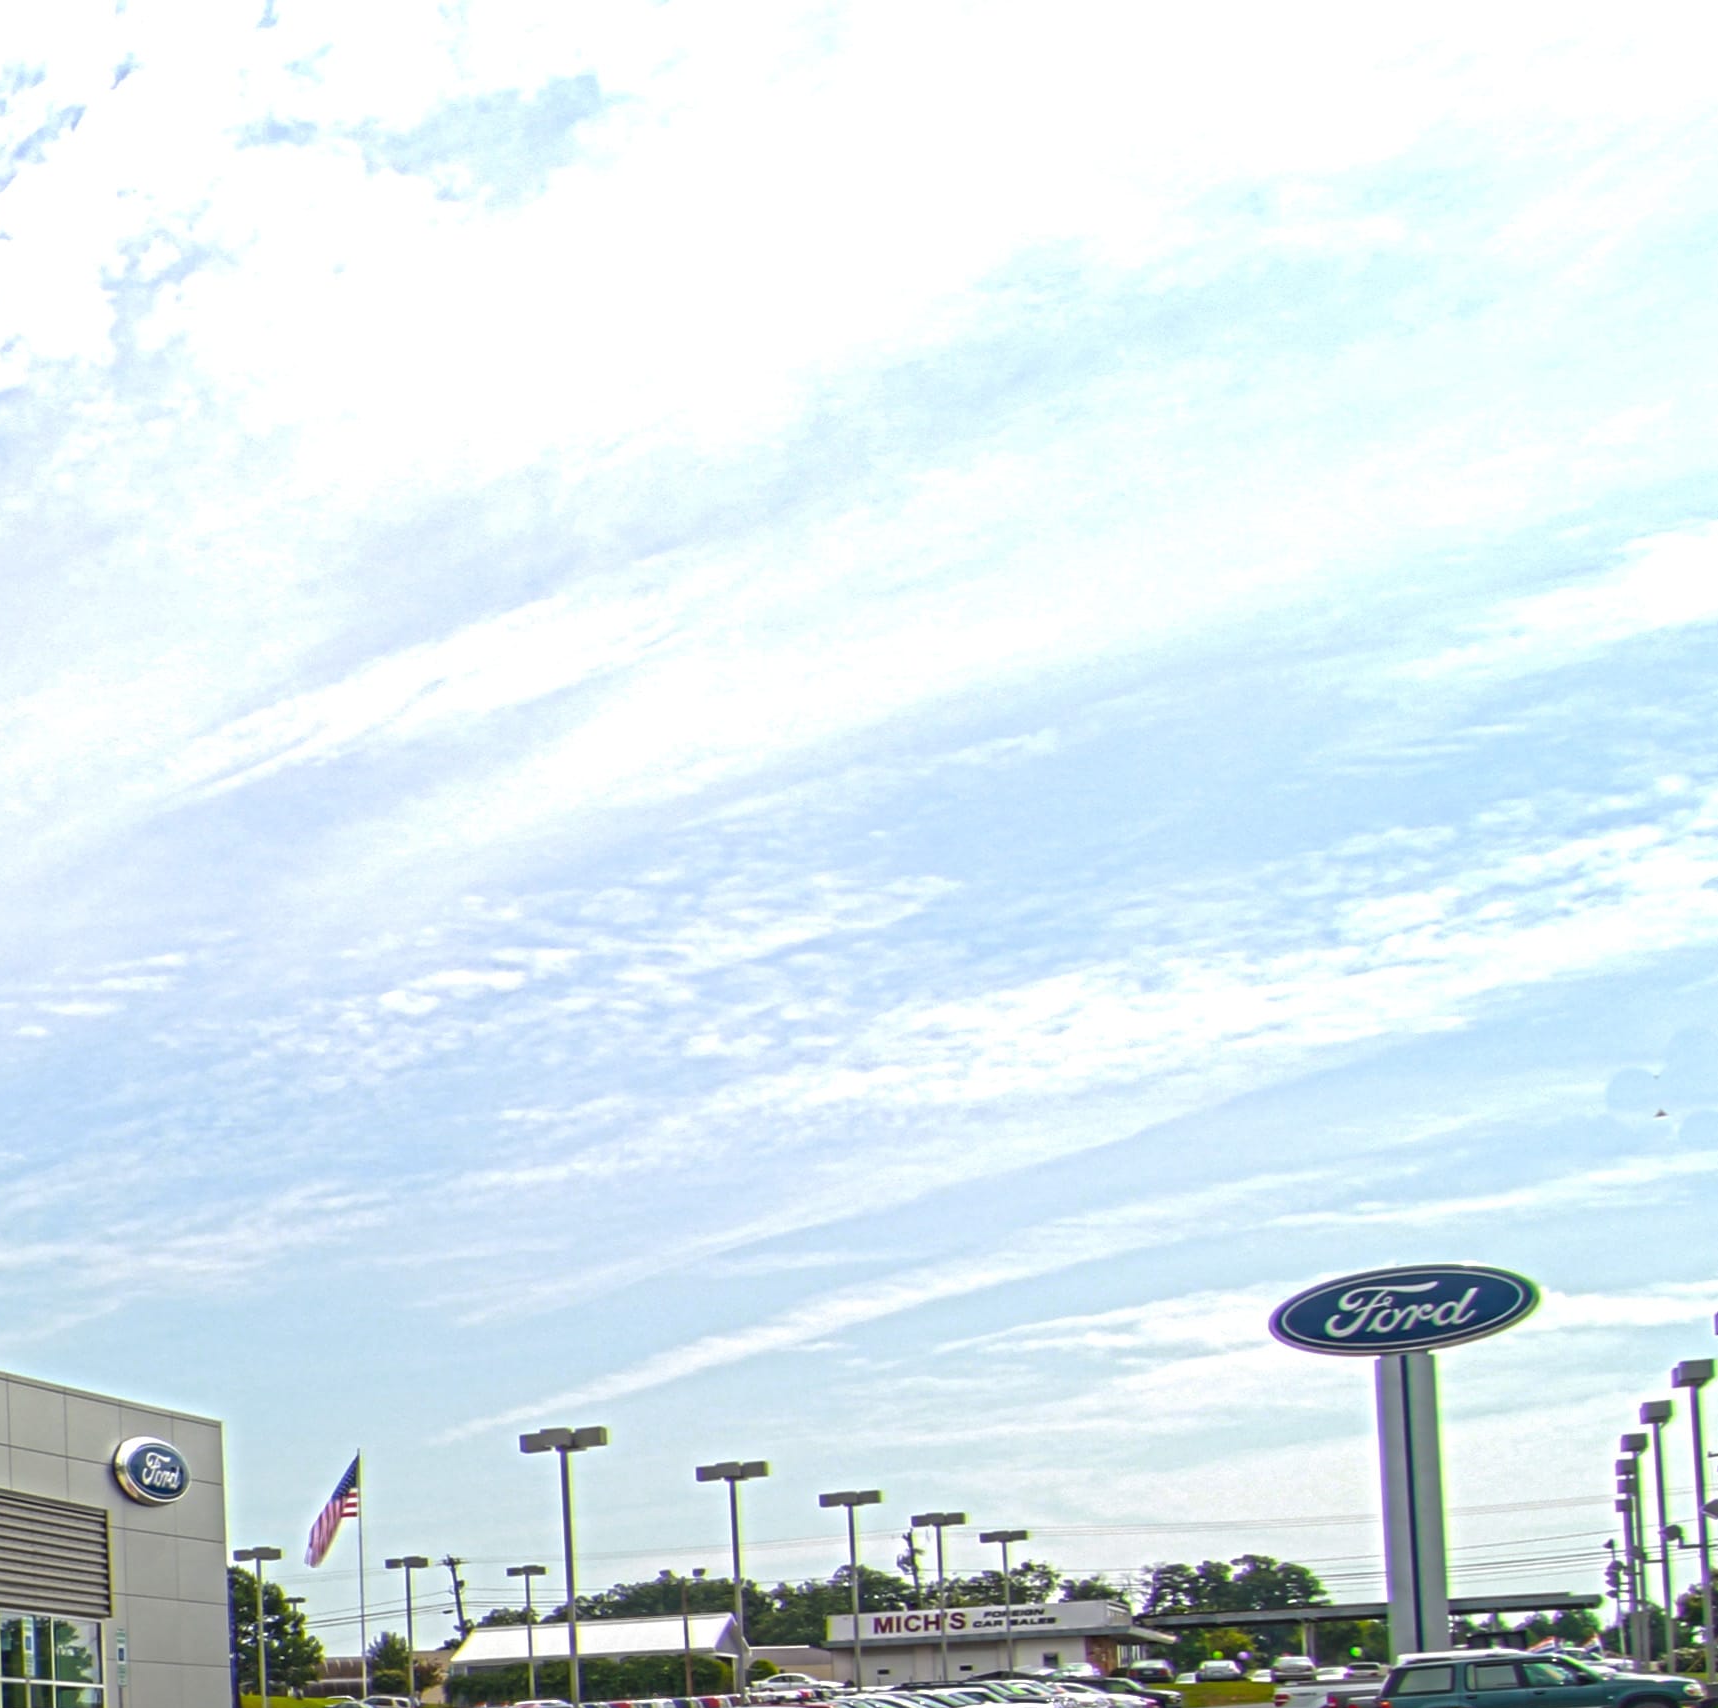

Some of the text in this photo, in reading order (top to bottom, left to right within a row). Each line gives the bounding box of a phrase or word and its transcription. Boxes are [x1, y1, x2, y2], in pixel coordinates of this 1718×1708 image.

[1324, 1281, 1479, 1338] Ford
[142, 1452, 181, 1489] Ford
[873, 1612, 966, 1634] MICH'S
[972, 1620, 1003, 1628] CAR
